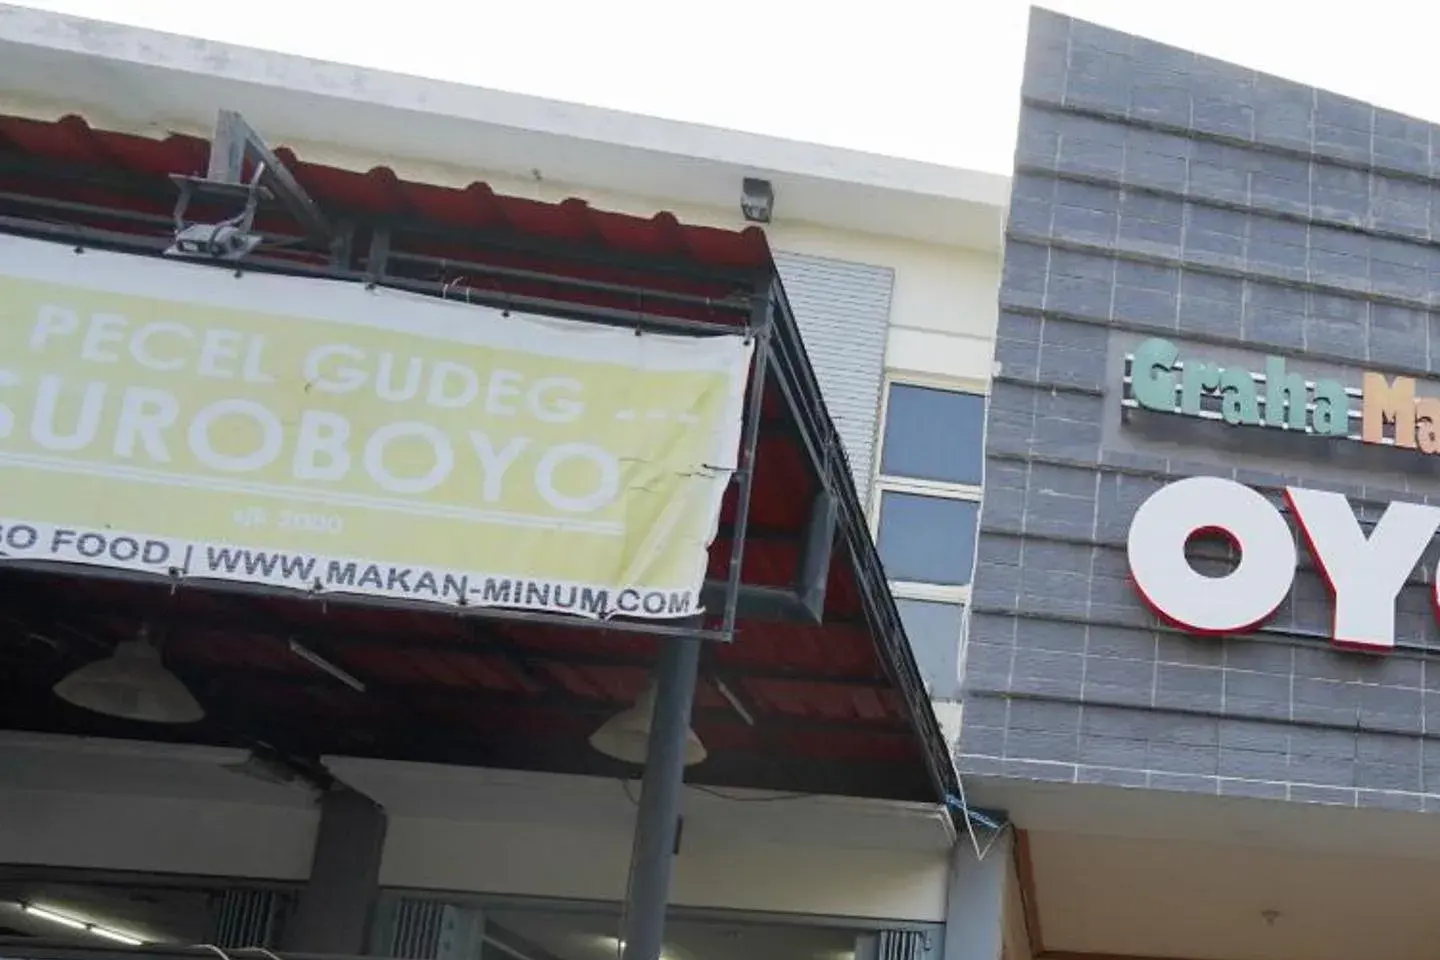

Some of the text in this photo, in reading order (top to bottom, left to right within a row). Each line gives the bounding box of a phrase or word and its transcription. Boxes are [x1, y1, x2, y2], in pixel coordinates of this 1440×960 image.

[28, 305, 586, 424] PECEL GUDEG
[1130, 338, 1349, 438] Graha
[0, 524, 692, 615] O FOOD WWW.MAKAN-MINUM.COM
